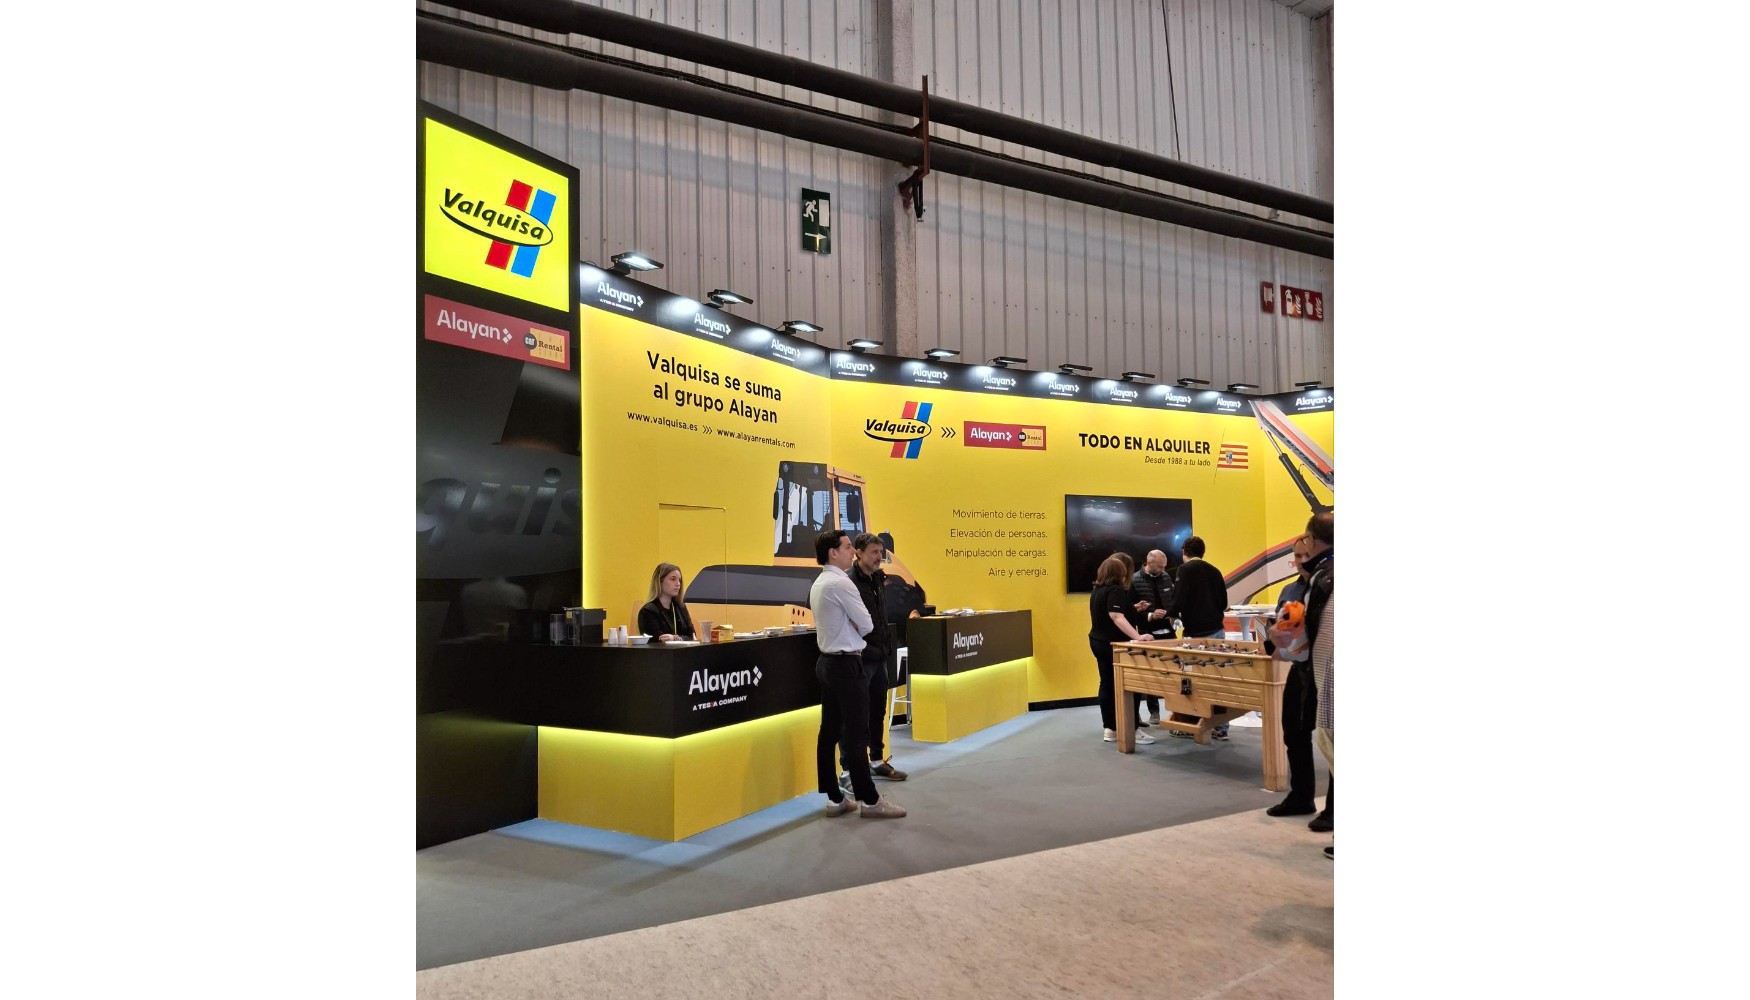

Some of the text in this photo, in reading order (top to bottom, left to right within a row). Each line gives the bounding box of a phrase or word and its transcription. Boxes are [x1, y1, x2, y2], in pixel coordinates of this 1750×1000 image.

[444, 187, 545, 241] Valquisa
[597, 281, 637, 305] Alayan
[694, 312, 726, 332] Alayan
[436, 309, 501, 340] Alayan
[538, 340, 563, 353] Rental
[771, 338, 797, 356] Alayan
[836, 358, 869, 372] Alayan
[647, 350, 781, 401] Valquisa se suma
[912, 367, 943, 379] Alayan
[983, 374, 1011, 387] Alayan
[1048, 380, 1075, 393] Alayan
[1109, 387, 1134, 398] Alayan
[1164, 392, 1188, 404] Alayan
[653, 382, 777, 423] al grupo Alayan
[1216, 397, 1238, 409] Alayan
[1295, 397, 1327, 407] Alayan
[627, 411, 796, 449] www.valquisa.es www.alayanrentals.com
[866, 418, 926, 436] Valquisa
[970, 427, 1005, 442] Alayan
[1078, 433, 1211, 454] TODO EN ALQUILER
[1144, 456, 1166, 464] Desde
[1168, 457, 1183, 465] 1988
[952, 508, 1048, 520] Movimiento de tierras.
[950, 528, 1048, 539] Elevación de personas.
[945, 547, 1048, 559] Manipulación de cargas.
[988, 567, 1049, 578] Aire y energía.
[953, 632, 979, 650] Alayan
[688, 668, 751, 696] Alayan
[718, 695, 747, 705] COMPANY
